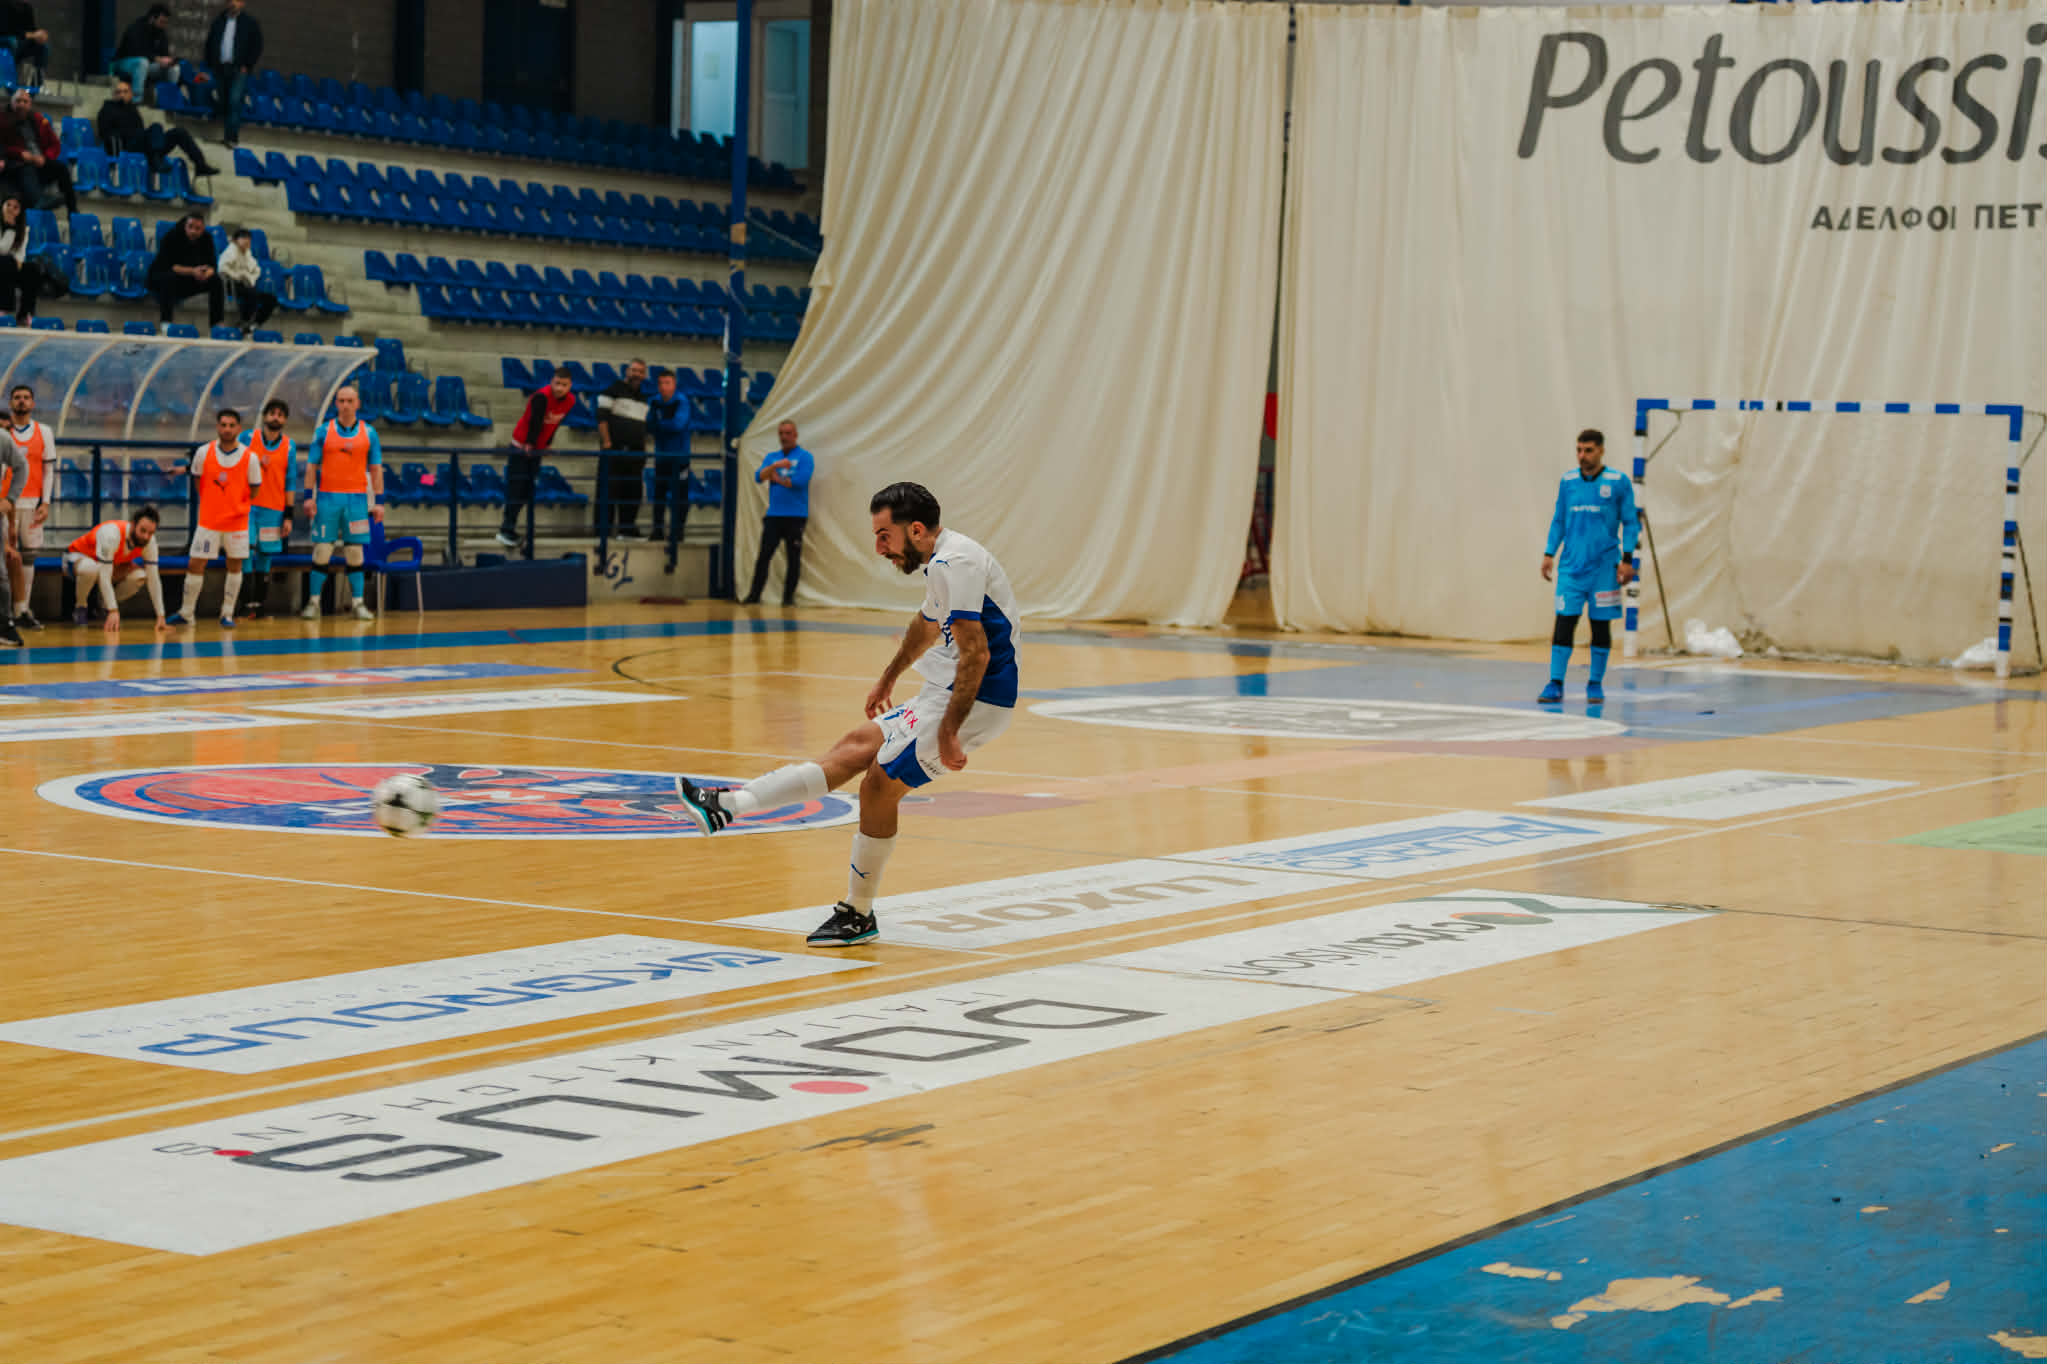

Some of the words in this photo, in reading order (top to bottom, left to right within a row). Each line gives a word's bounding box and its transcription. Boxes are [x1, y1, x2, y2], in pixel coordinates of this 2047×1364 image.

[1517, 23, 2047, 166] Petoussi
[1811, 205, 1957, 232] ΑΔΕΛΦΟΙ
[896, 873, 1258, 937] LUXOR
[1200, 921, 1496, 976] cytavision
[692, 991, 1008, 1051] ITALIAN
[152, 1054, 675, 1157] KITCHENS
[232, 998, 1167, 1183] DOMUS
